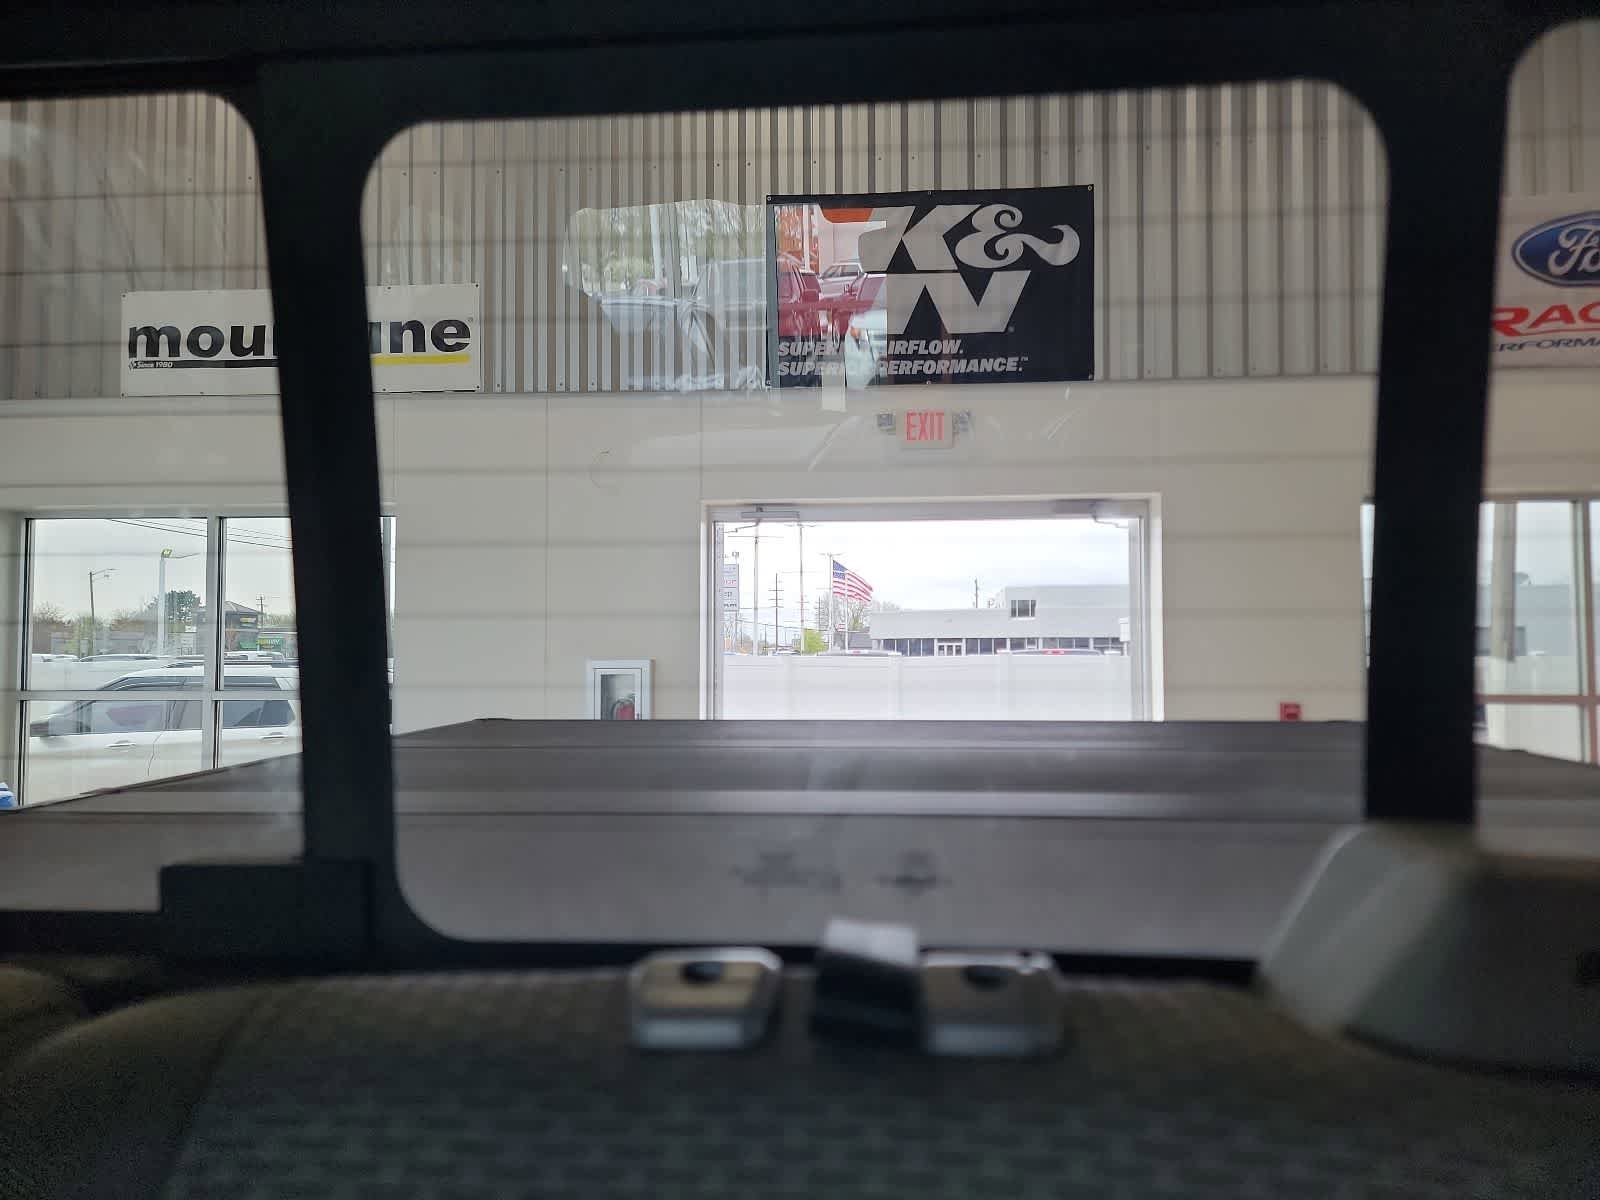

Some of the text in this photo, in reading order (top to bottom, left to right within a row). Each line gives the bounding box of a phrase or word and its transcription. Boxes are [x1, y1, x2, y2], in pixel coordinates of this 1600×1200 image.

[1547, 224, 1600, 276] Fo
[1492, 302, 1600, 337] RAC
[872, 339, 963, 355] IRFLOW.
[906, 411, 945, 441] EXIT
